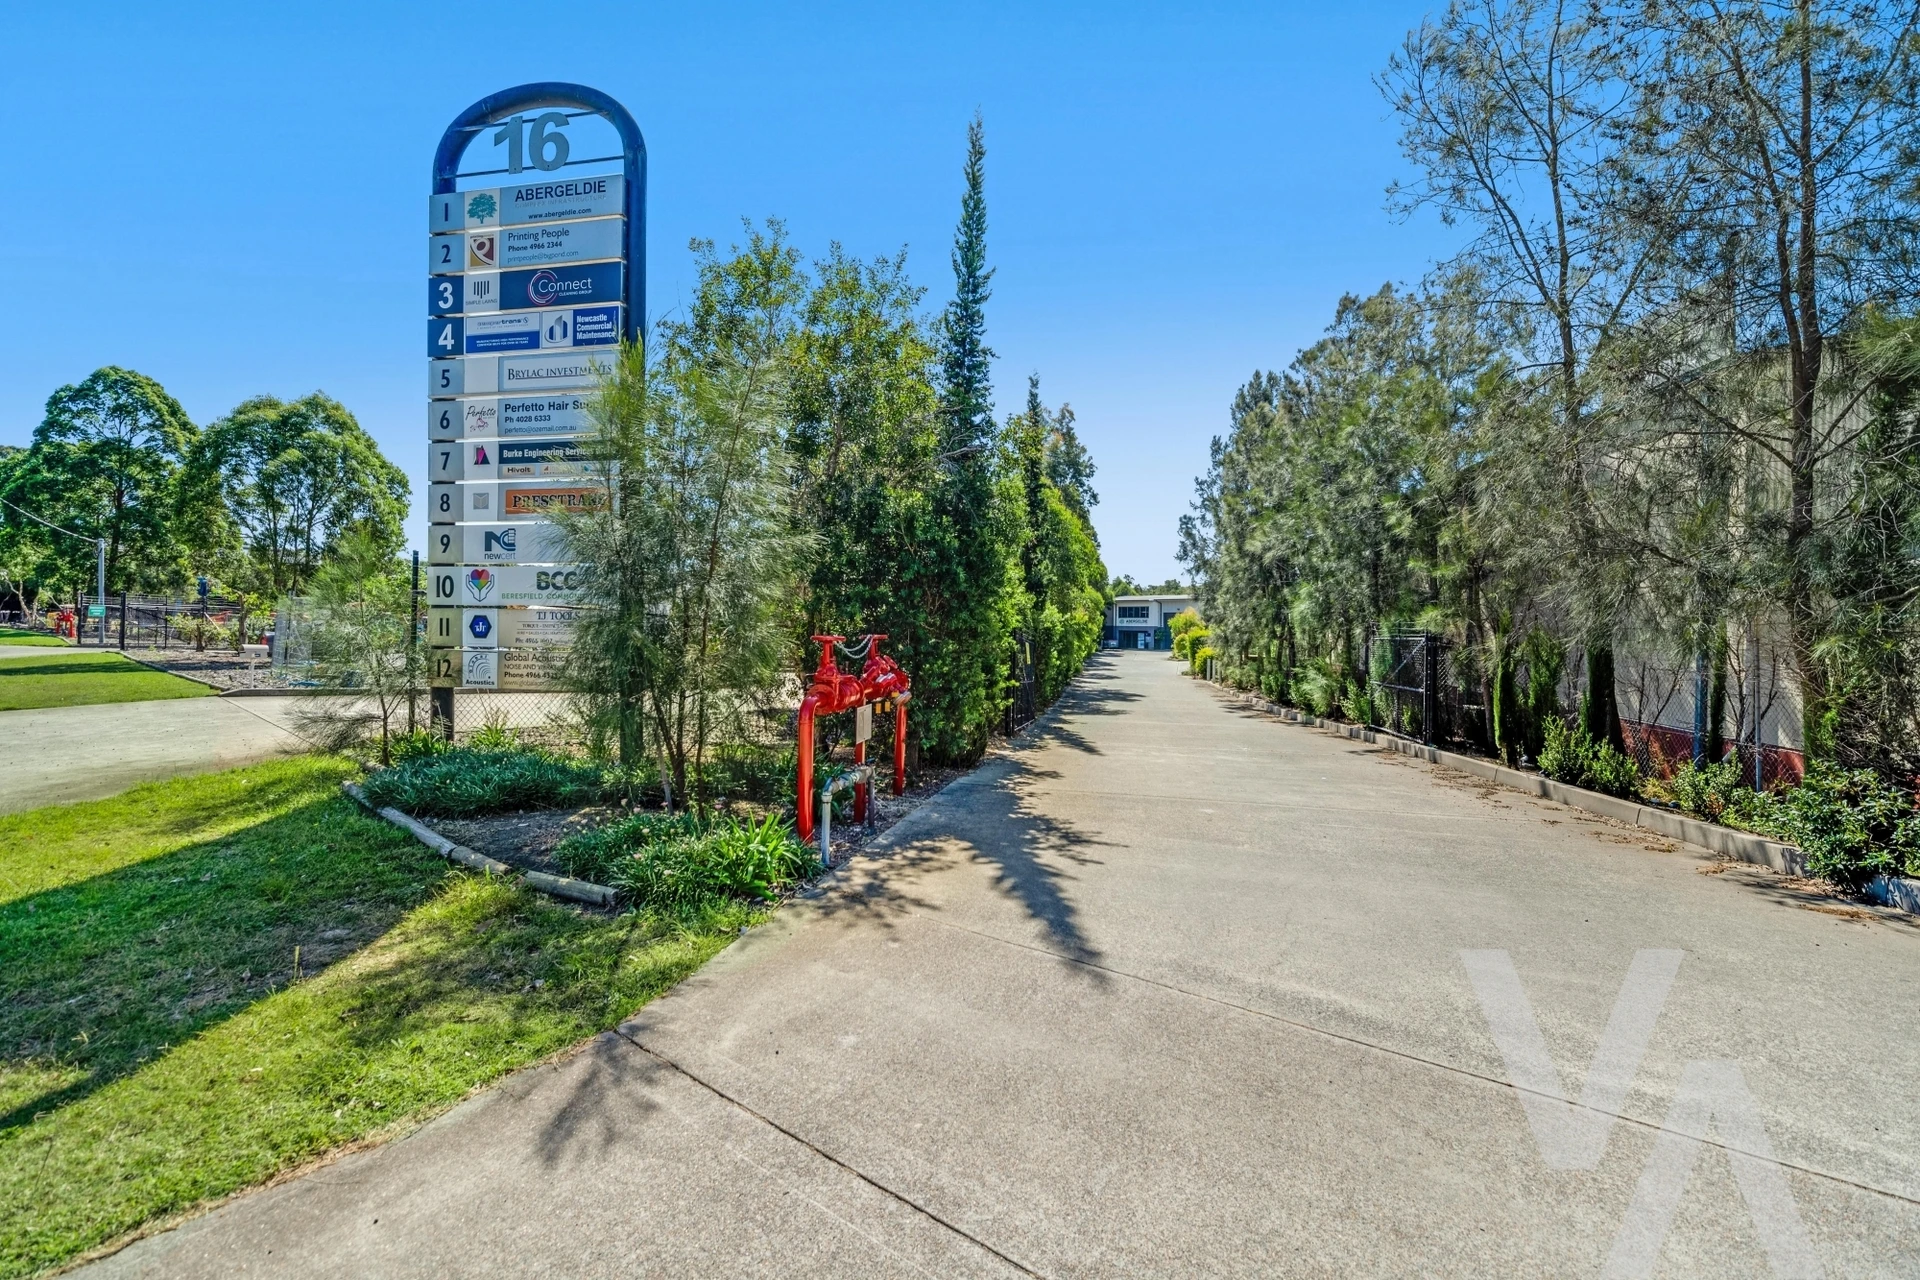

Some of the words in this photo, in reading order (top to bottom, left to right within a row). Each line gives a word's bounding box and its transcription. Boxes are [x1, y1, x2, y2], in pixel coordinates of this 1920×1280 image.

[494, 112, 570, 174] 16
[514, 180, 607, 202] ABERGELDIE
[444, 203, 449, 222] 1
[528, 207, 592, 220] www.abergeldie.com
[508, 231, 539, 242] Printing
[541, 228, 570, 240] People
[546, 241, 563, 249] 2344
[441, 244, 451, 264] 2
[538, 278, 592, 293] Connect
[438, 282, 454, 309] 3
[576, 314, 608, 323] Newcastle
[576, 322, 612, 332] Commercial
[576, 330, 616, 340] Maintenance
[438, 324, 455, 350] 4
[440, 369, 450, 388] 5
[508, 368, 544, 380] BRYLAC
[465, 406, 496, 420] Perfetto
[504, 403, 544, 413] Perfetto
[548, 401, 570, 411] Hair
[440, 410, 450, 429] 6
[440, 452, 450, 470] 7
[503, 450, 523, 458] Burke
[524, 448, 564, 458] Engineering
[440, 494, 450, 512] 8
[440, 534, 450, 553] 9
[484, 552, 516, 560] newcert
[436, 575, 455, 598] 10
[536, 570, 579, 591] BCC
[502, 592, 543, 600] BERESFIELD
[550, 611, 581, 621] TOOLS
[439, 618, 450, 636] 11
[504, 652, 530, 662] Global
[437, 660, 452, 678] 12
